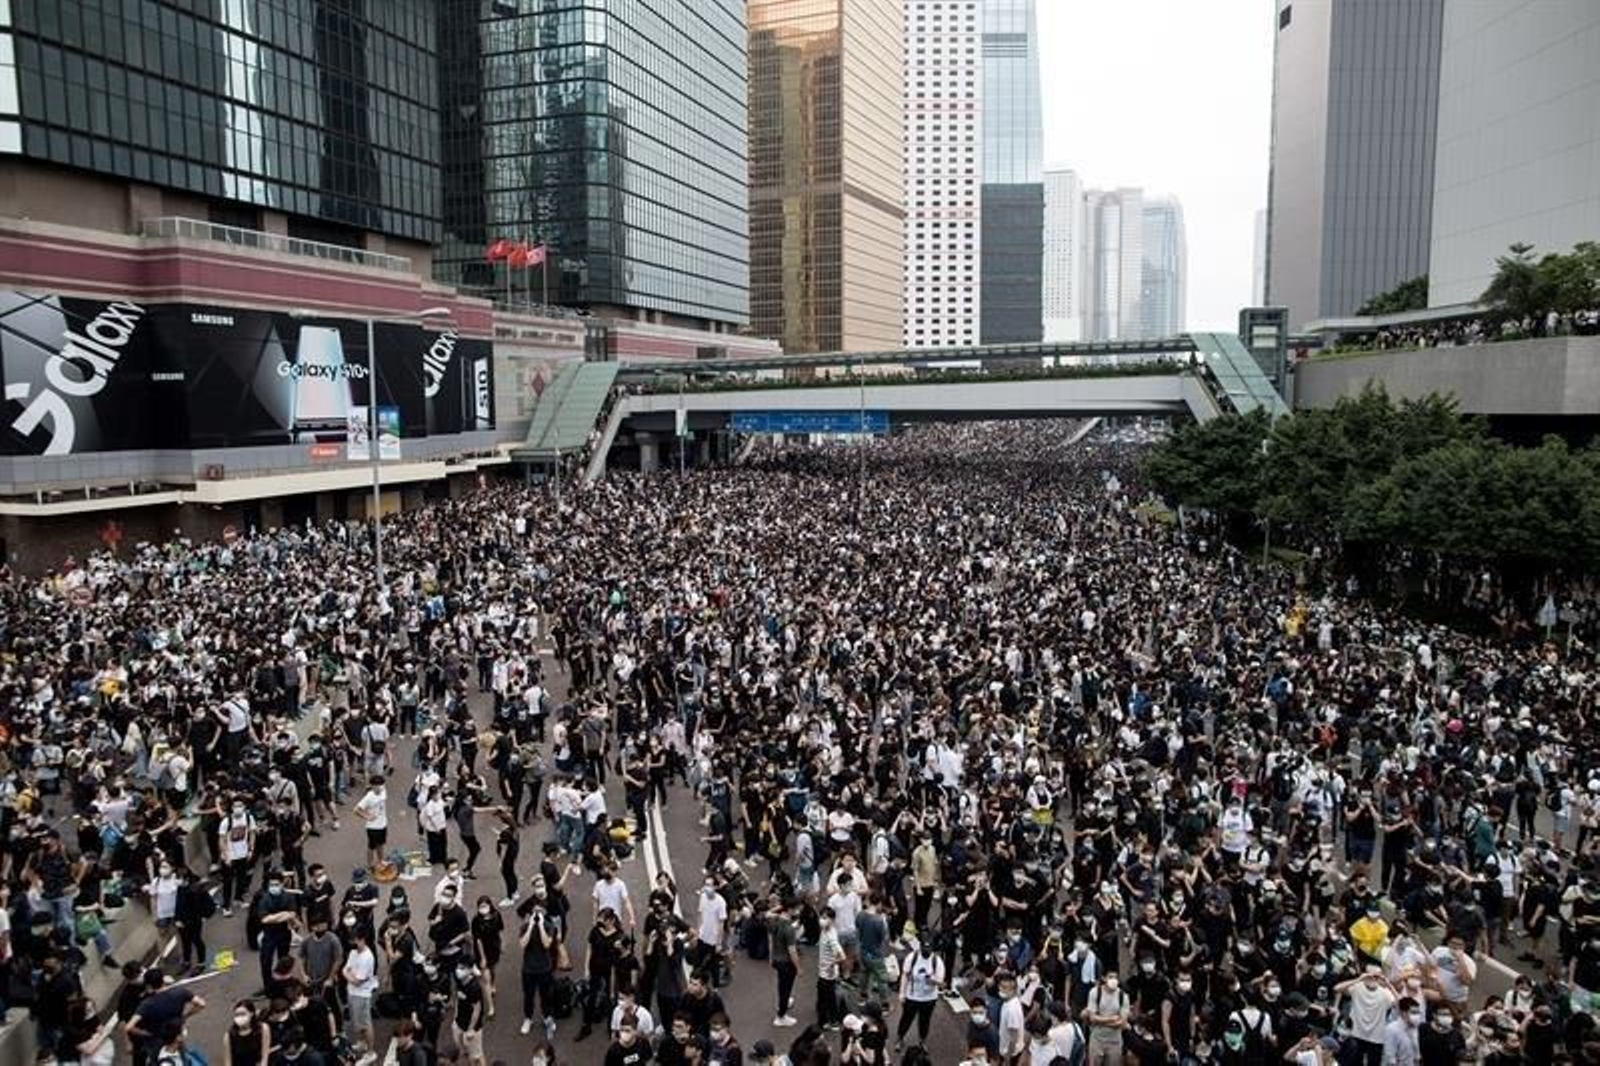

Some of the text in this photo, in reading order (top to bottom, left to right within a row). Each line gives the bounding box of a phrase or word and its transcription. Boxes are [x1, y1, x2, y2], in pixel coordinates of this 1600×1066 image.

[191, 313, 235, 326] SAMSUNG
[5, 301, 147, 455] Galaxy
[152, 372, 185, 381] SAMSUNG
[277, 361, 338, 381] Galaxy
[477, 370, 489, 410] S10
